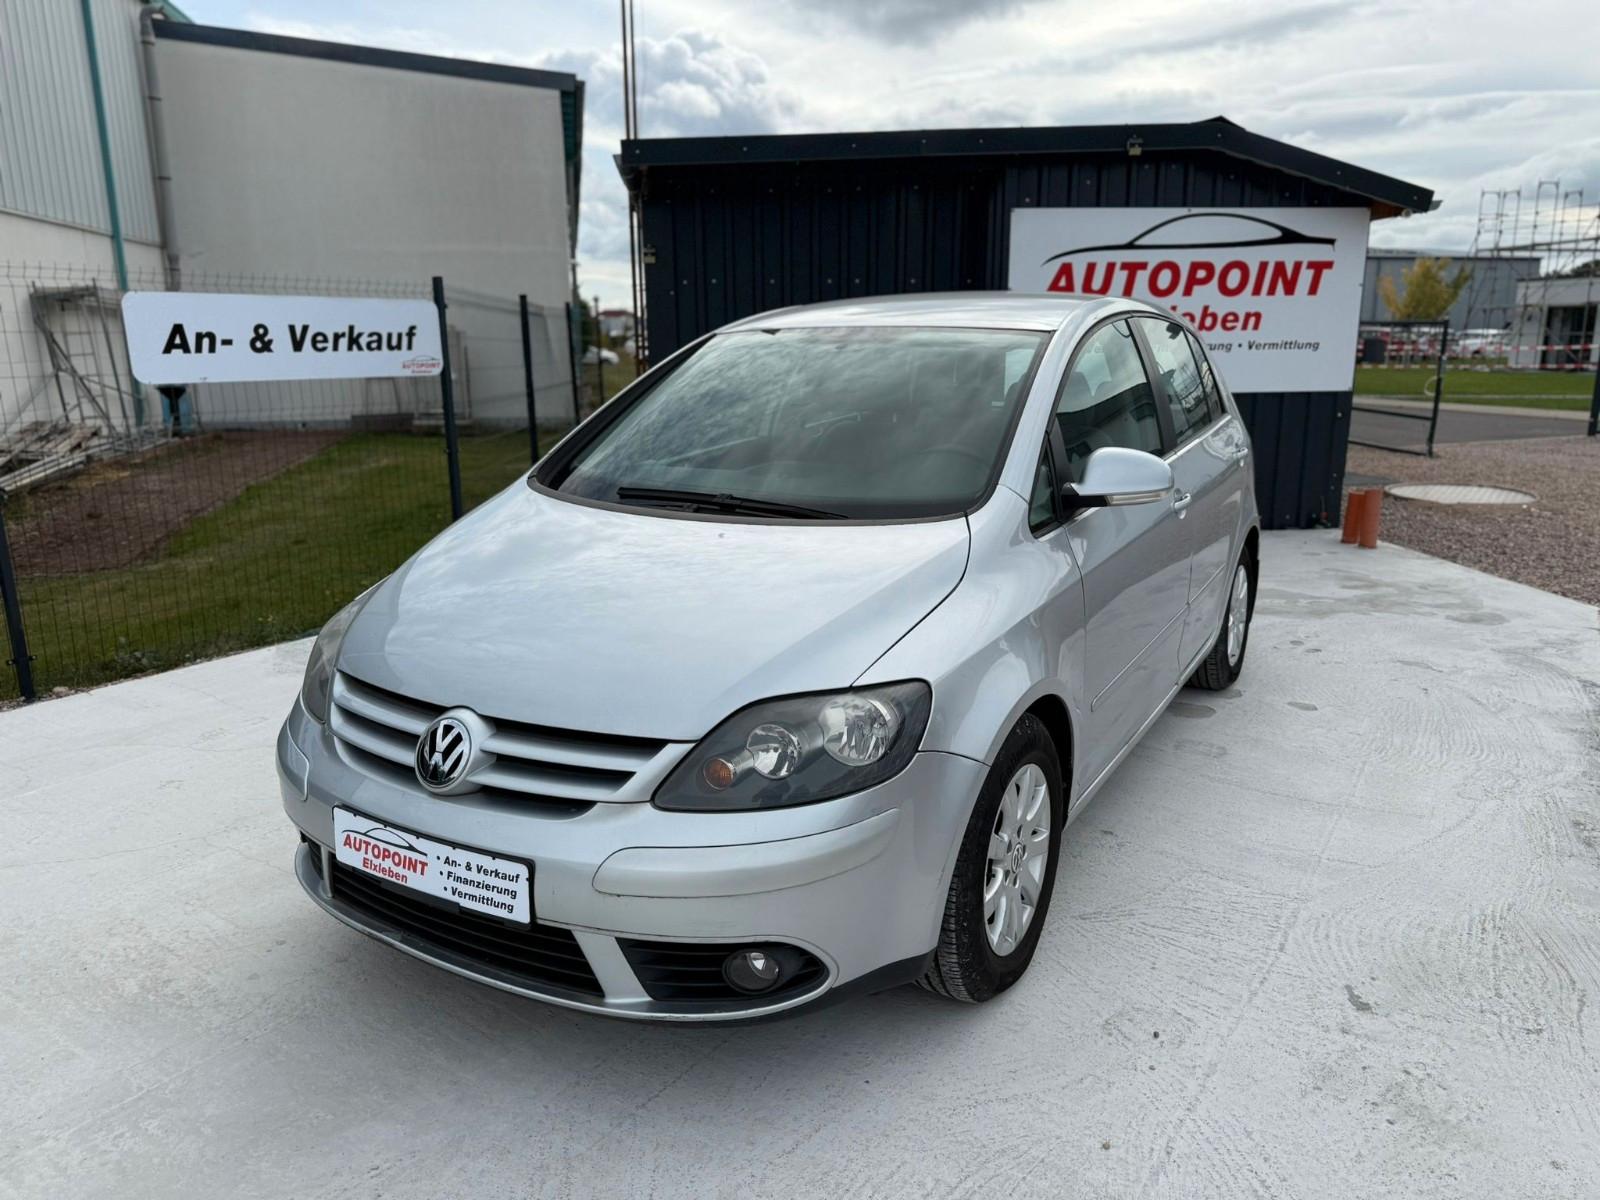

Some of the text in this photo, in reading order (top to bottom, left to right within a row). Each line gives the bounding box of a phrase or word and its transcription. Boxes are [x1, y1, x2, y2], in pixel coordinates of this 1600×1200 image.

[1047, 260, 1335, 298] AUTOPOINT
[162, 323, 417, 354] An- & Verkauf
[1247, 340, 1321, 352] Vermittlung
[343, 833, 428, 876] AUTOPOINT
[443, 856, 520, 884] An- & Verkauf
[446, 870, 518, 900] Finanzierung
[451, 886, 514, 914] Vermittlung
